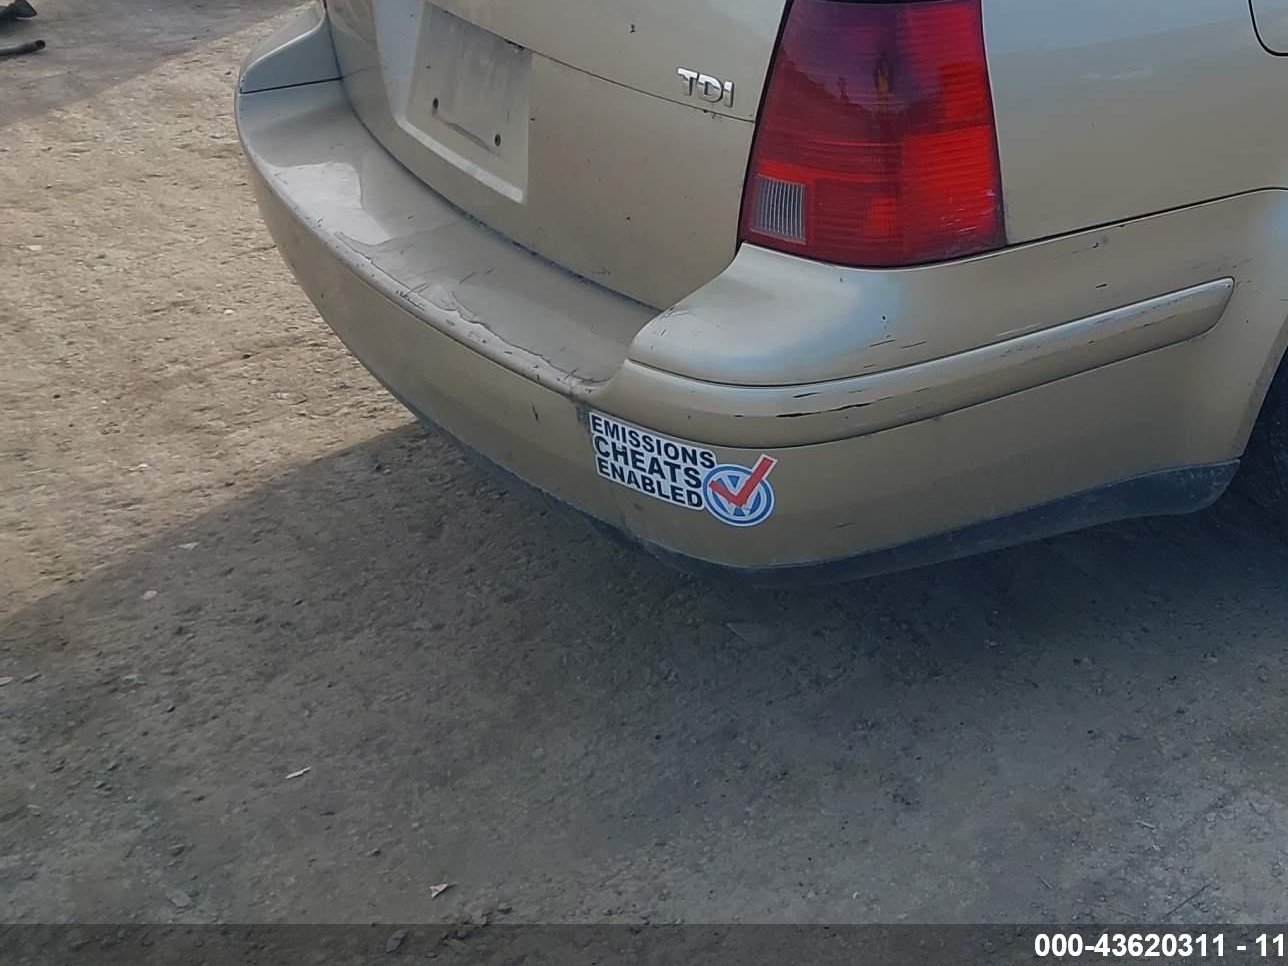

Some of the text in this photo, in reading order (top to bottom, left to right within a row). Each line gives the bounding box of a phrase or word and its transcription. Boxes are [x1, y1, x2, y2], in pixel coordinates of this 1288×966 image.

[677, 67, 735, 108] TDI
[591, 414, 716, 469] EMISSIONS
[594, 436, 702, 489] CHEATS
[597, 457, 704, 509] ENABLED
